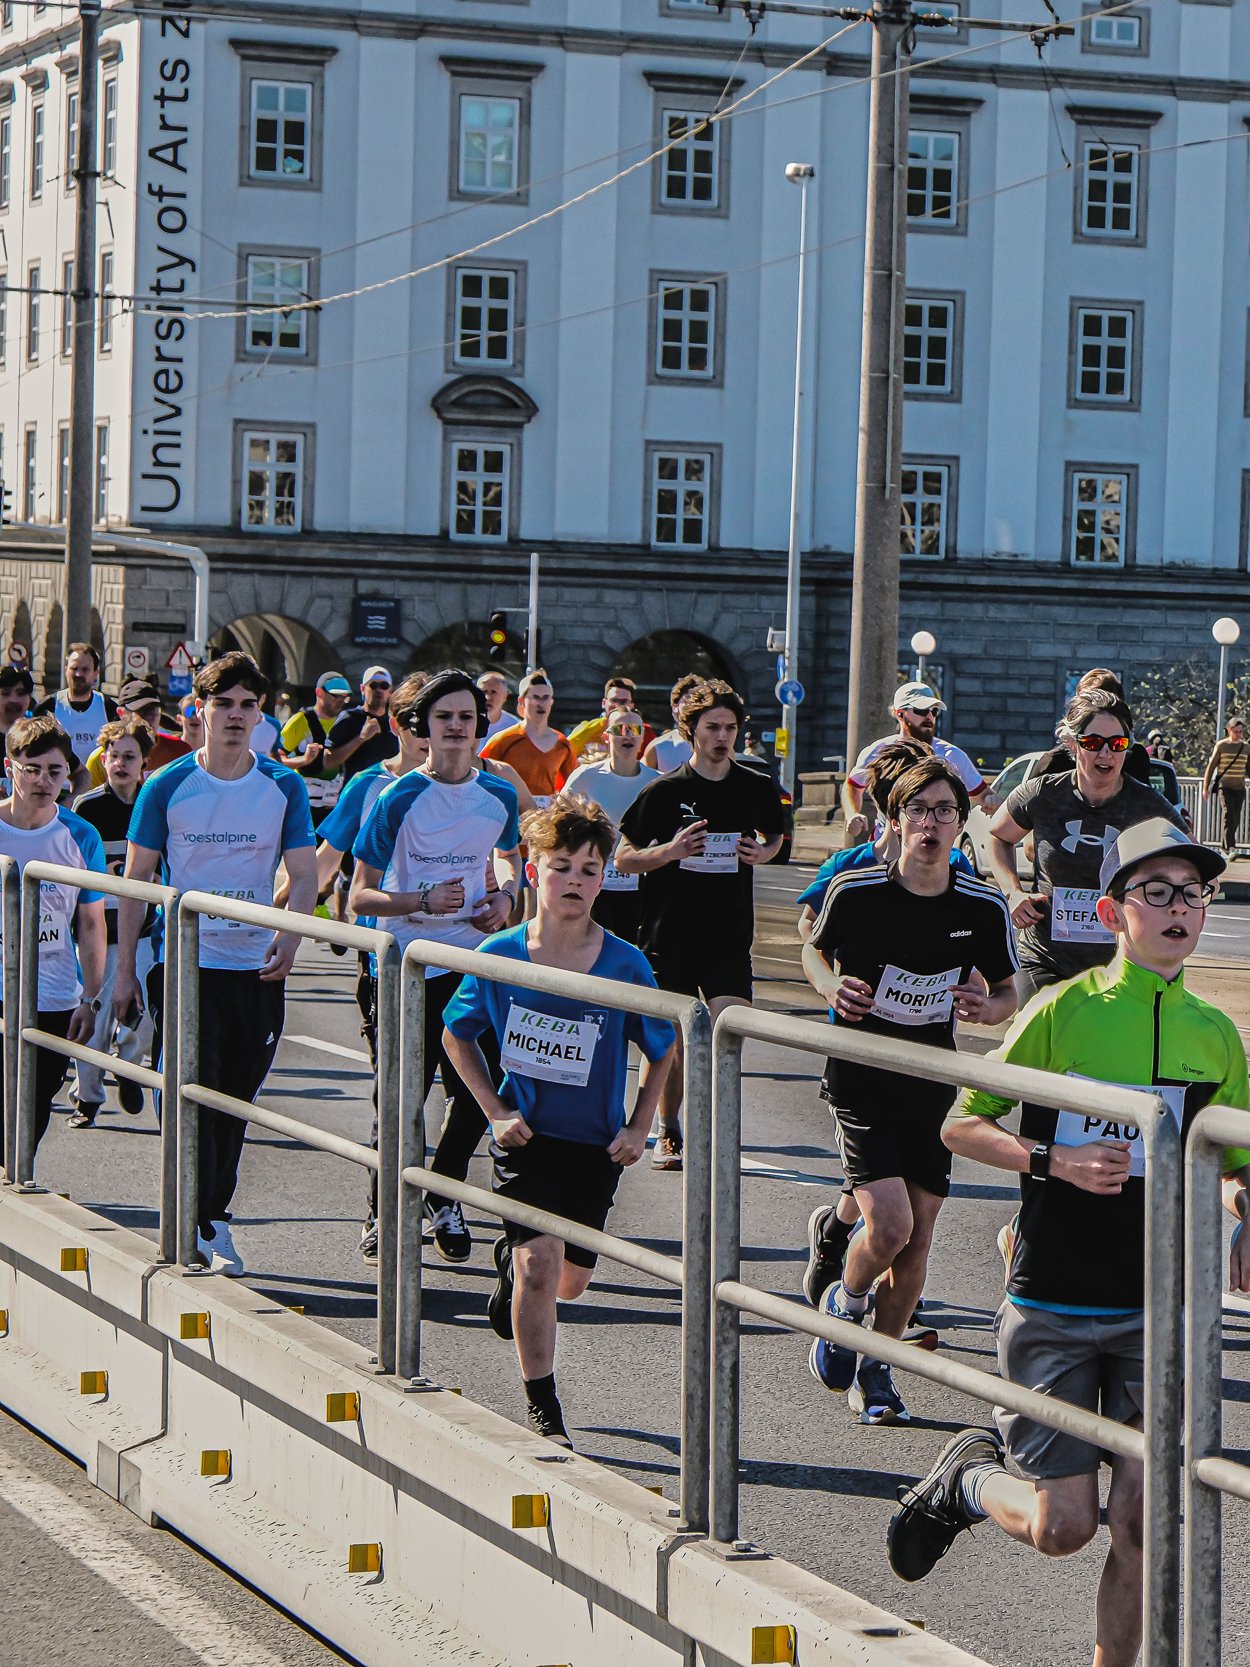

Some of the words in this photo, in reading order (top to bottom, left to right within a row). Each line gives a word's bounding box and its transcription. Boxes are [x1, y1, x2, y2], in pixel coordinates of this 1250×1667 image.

[149, 58, 190, 173] Arts
[148, 184, 188, 235] of
[141, 245, 197, 514] University
[75, 732, 95, 741] BSV
[182, 831, 257, 845] voestalpine
[408, 850, 478, 866] voestalpine
[1063, 890, 1102, 902] KEB
[1055, 909, 1102, 923] STEFA
[949, 930, 973, 938] adidas
[895, 972, 947, 988] KEBA
[884, 986, 948, 1007] MORITZ
[520, 1012, 581, 1036] KEBA
[507, 1029, 587, 1062] MICHAEL
[535, 1056, 552, 1066] 1854
[1082, 1115, 1145, 1142] PAU
